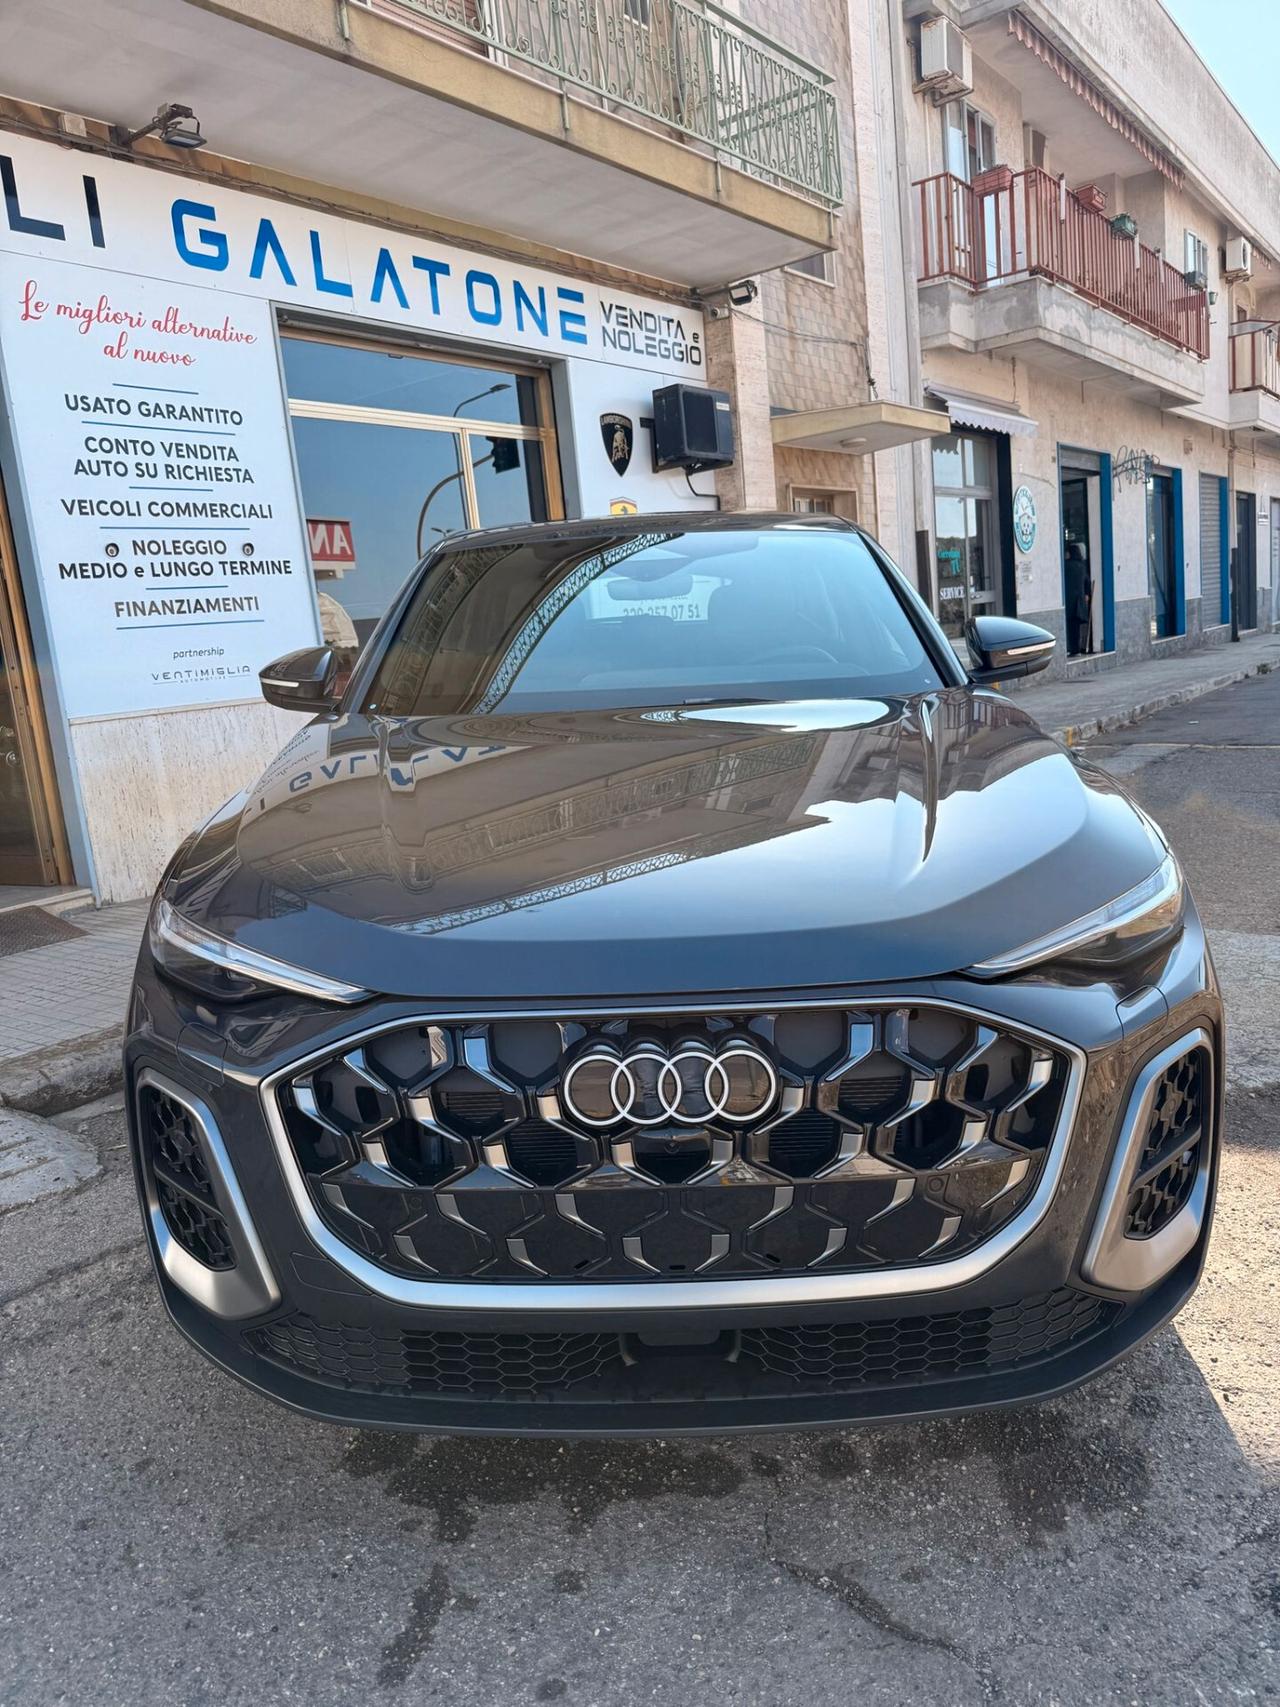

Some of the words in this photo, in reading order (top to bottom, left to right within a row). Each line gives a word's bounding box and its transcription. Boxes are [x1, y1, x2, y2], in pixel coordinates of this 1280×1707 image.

[171, 199, 588, 345] GALATONE
[18, 280, 49, 321] Le
[56, 295, 146, 334] migliori
[152, 306, 258, 344] alternative
[600, 300, 686, 341] VENDITA
[692, 332, 700, 343] e
[104, 331, 128, 359] al
[134, 348, 197, 366] nuovo
[602, 326, 702, 366] NOLEGGIO
[64, 394, 131, 416] USATO
[138, 401, 243, 426] GARANTITO
[84, 436, 155, 456] CONTO
[160, 441, 240, 462] VENDITA
[74, 459, 128, 477] AUTO
[135, 462, 158, 478] SU
[164, 463, 255, 484] RICHIESTA
[60, 499, 142, 517] VEICOLI
[147, 501, 273, 519] COMMERCIALI
[132, 540, 227, 556] NOLEGGIO
[58, 562, 128, 579] MEDIO
[134, 565, 144, 578] e
[150, 561, 214, 578] LUNGO
[219, 560, 292, 576] TERMINE
[114, 596, 260, 618] FINANZIAMENTI
[671, 604, 684, 620] 07
[688, 603, 701, 618] 51
[173, 647, 225, 659] partnership
[152, 665, 251, 681] VENTIMIGLIA
